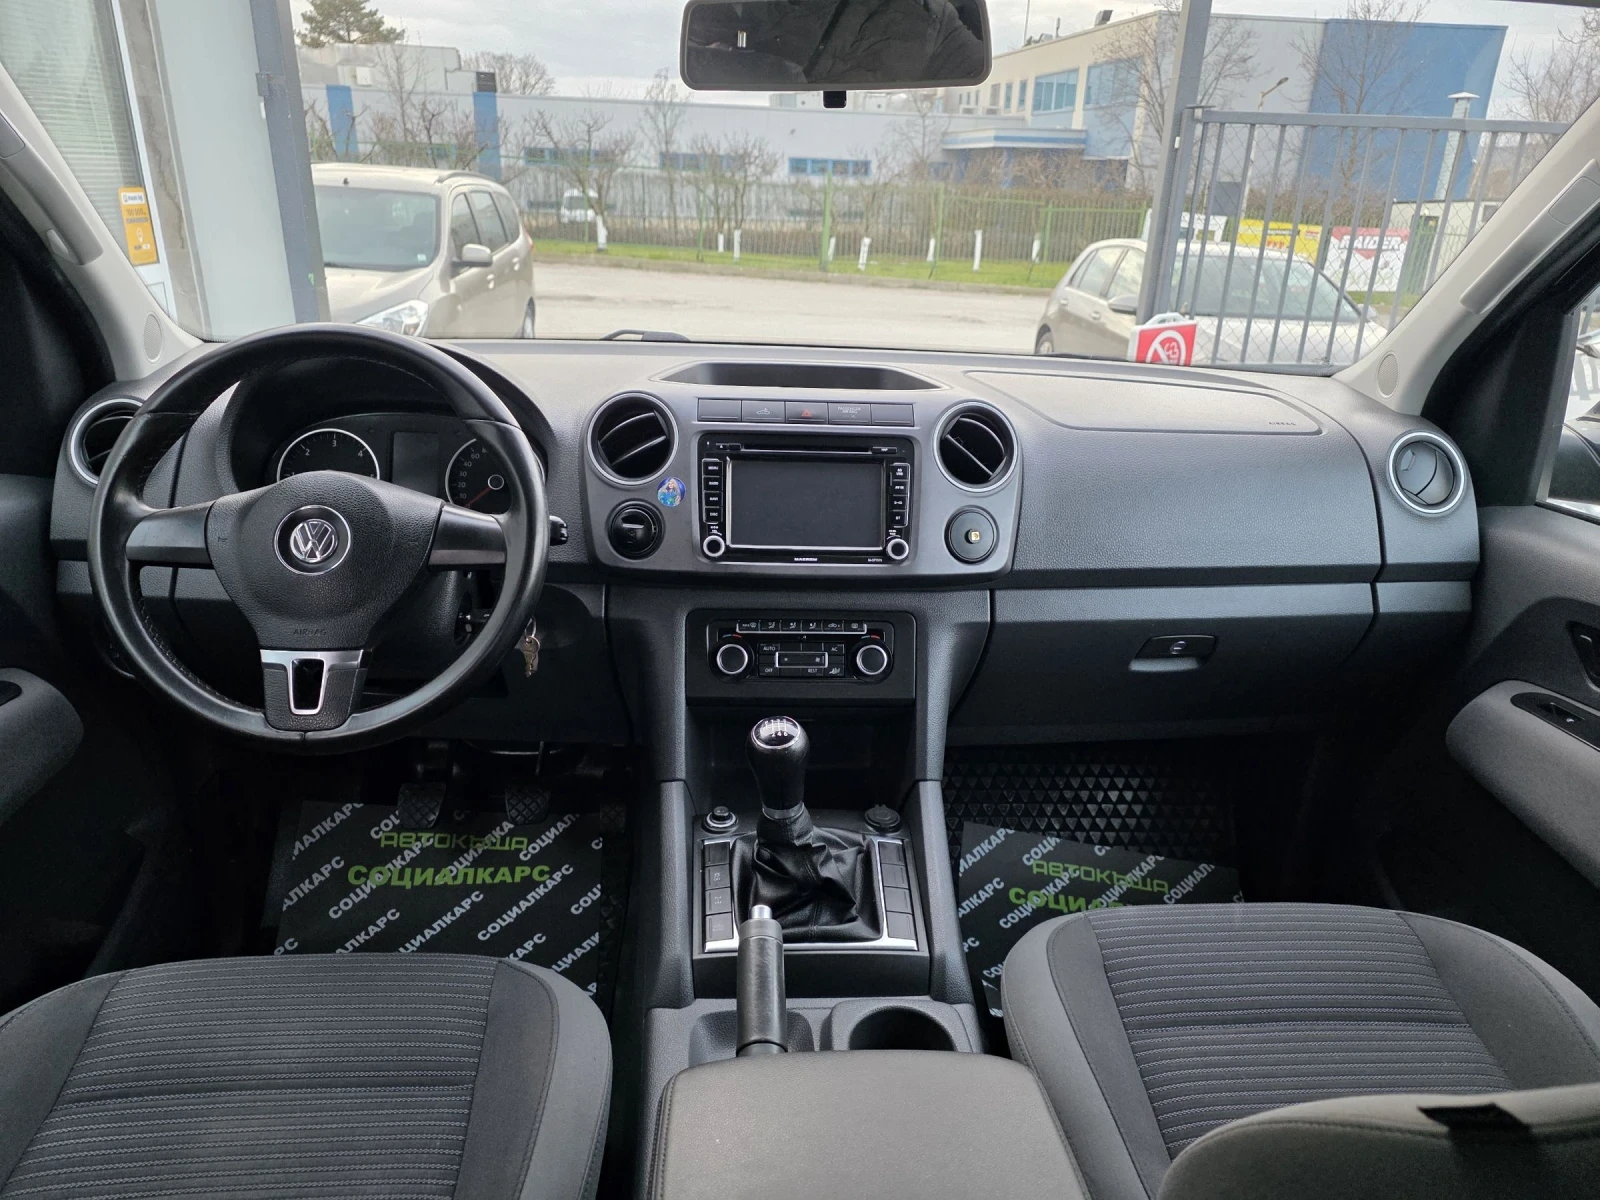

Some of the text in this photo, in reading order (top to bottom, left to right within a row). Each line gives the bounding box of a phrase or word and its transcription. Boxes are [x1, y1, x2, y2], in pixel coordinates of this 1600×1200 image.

[1022, 836, 1063, 866] СОЦИ
[348, 864, 552, 890] СОЦИАЛКАРС
[477, 864, 574, 942] СОЦИАЛКАРС
